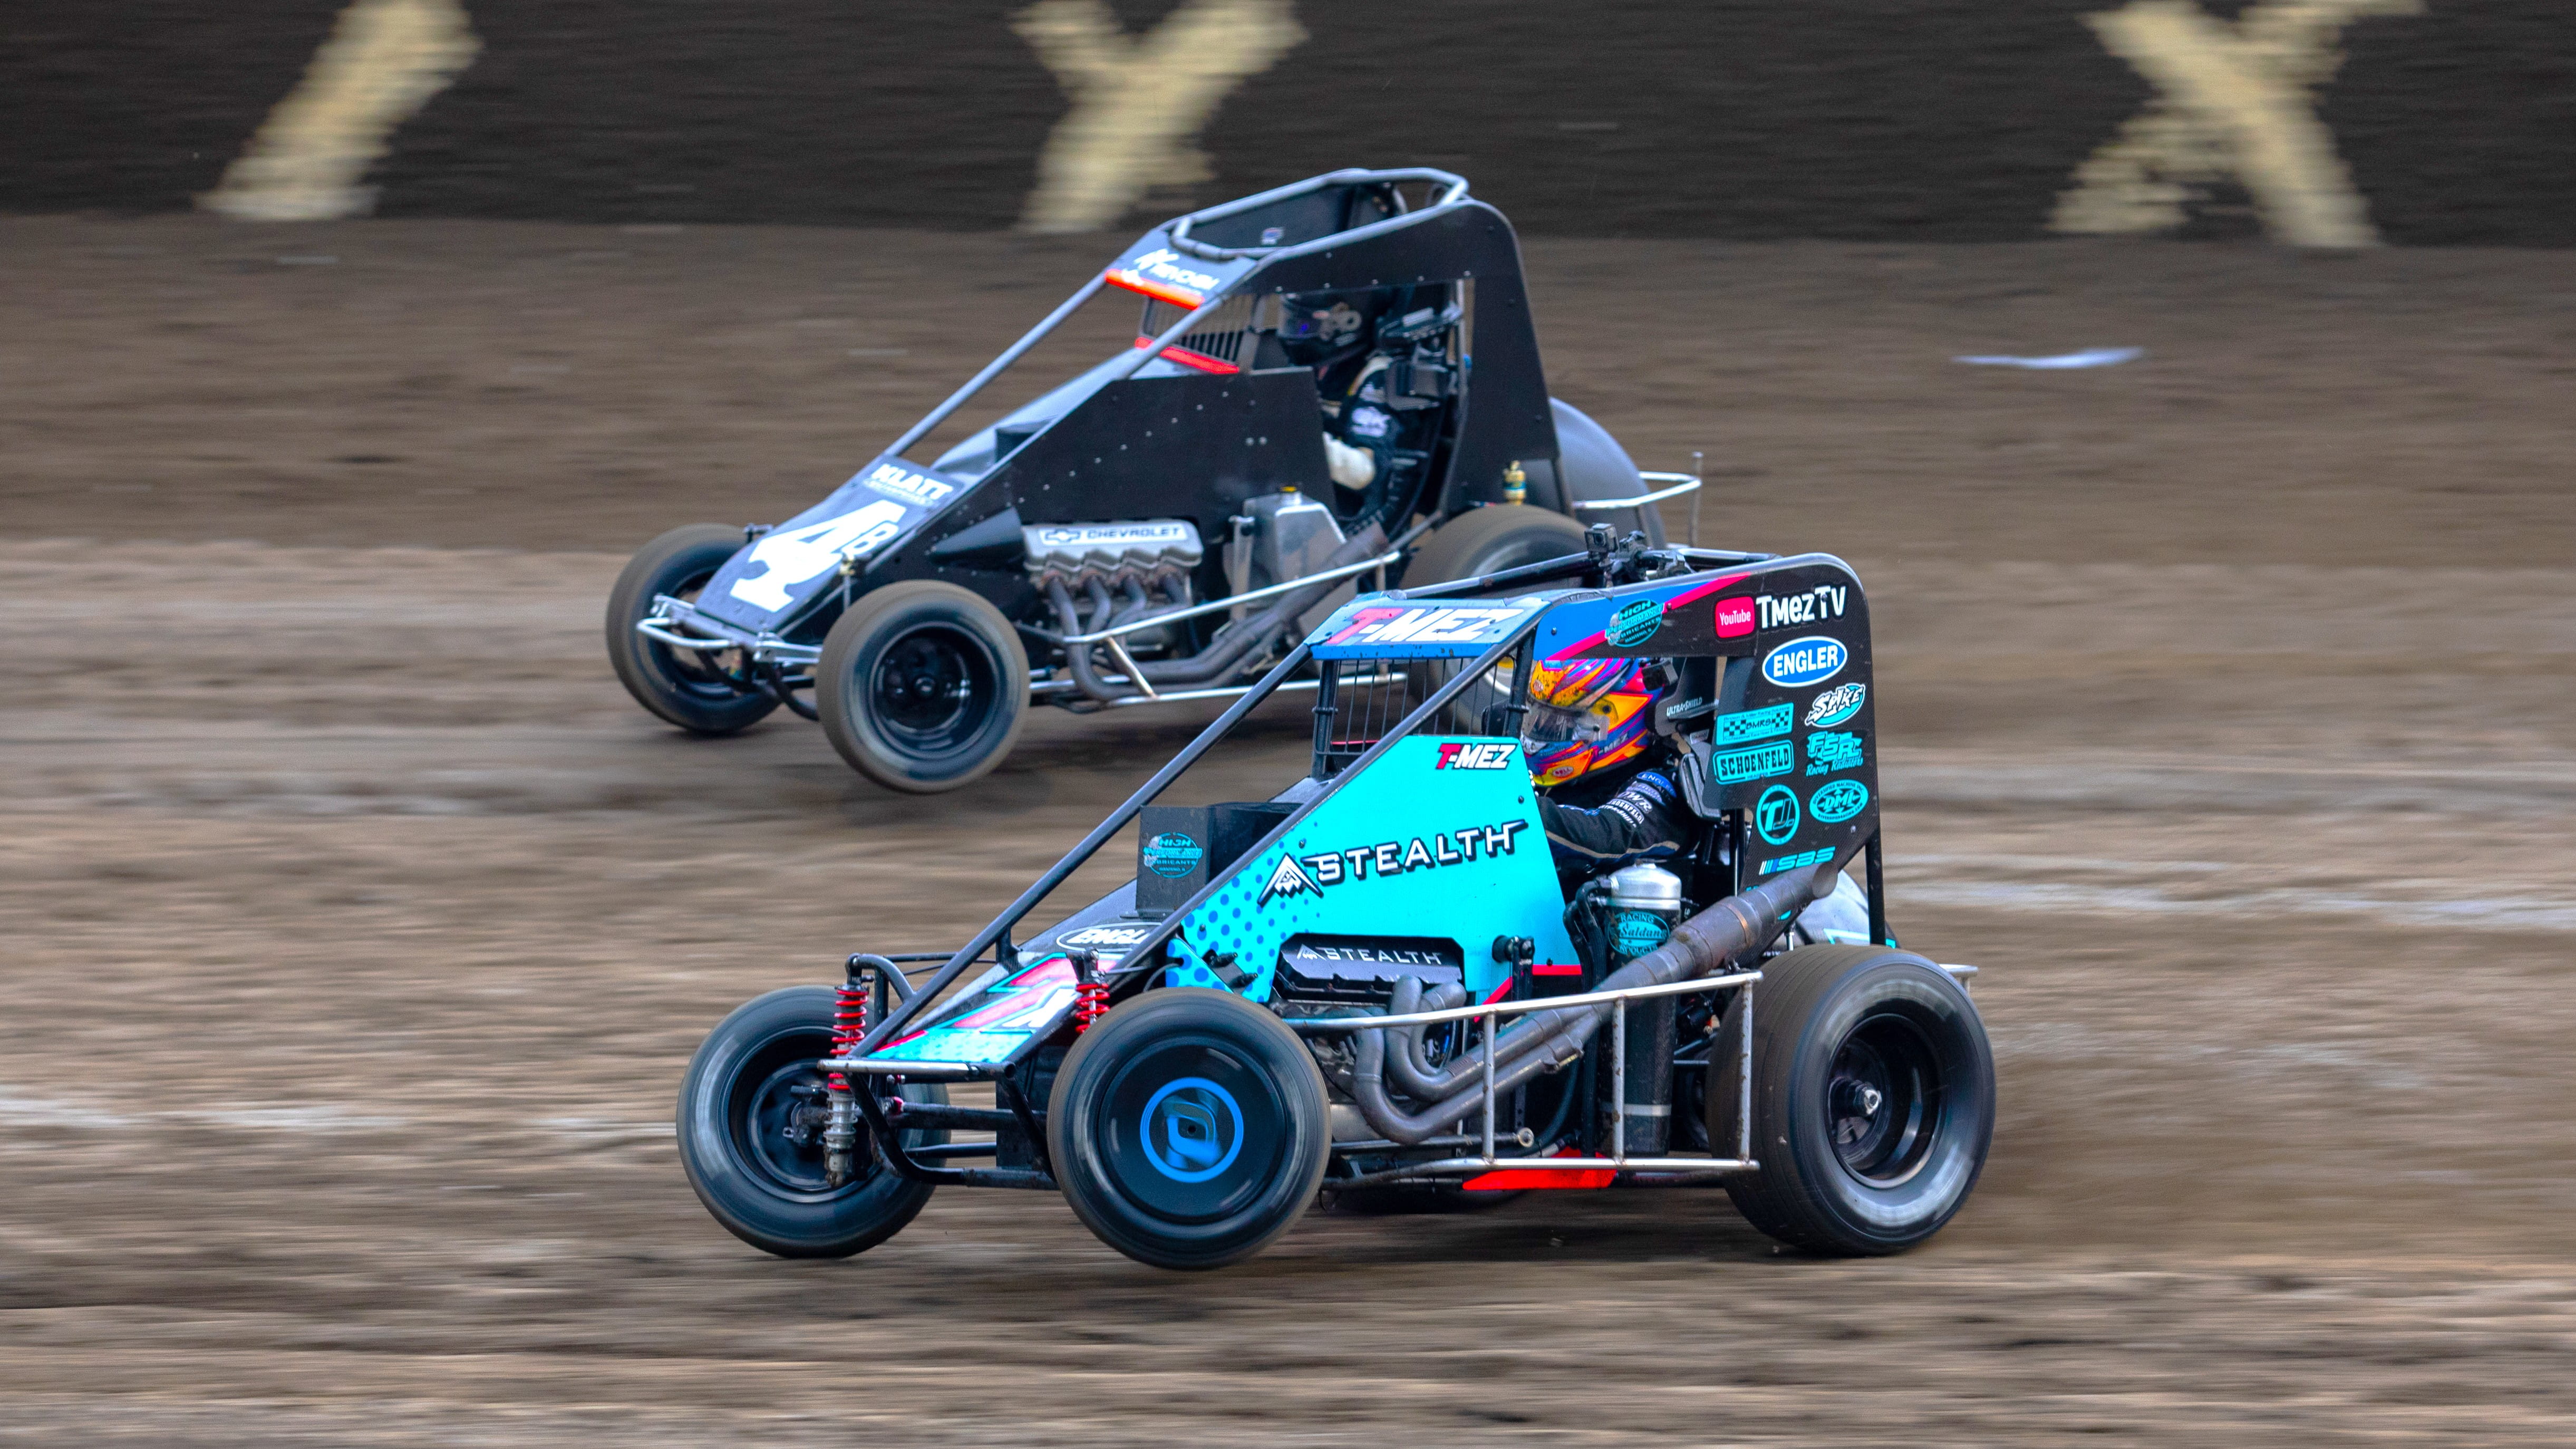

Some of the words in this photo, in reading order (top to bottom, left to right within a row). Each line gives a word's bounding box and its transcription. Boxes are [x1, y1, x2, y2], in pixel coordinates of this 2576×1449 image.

[871, 463, 953, 500] KLATT
[1087, 527, 1180, 538] CHEVROLET
[1619, 600, 1651, 621] HIGH
[1719, 610, 1751, 625] YouTube
[1326, 608, 1525, 644] T-MEZ
[1773, 645, 1838, 678] ENGLER
[1806, 687, 1864, 722] SPIKE
[1436, 743, 1517, 770] T-MEZ
[1808, 731, 1862, 762] FSR
[1720, 748, 1789, 777] SCHOENFELD
[1806, 764, 1828, 777] Racing
[1823, 790, 1855, 811] DMI
[1301, 819, 1528, 885] STEALTH
[1620, 913, 1654, 924] RACING
[1066, 929, 1151, 944] ENGL
[1315, 946, 1444, 965] STEALTH
